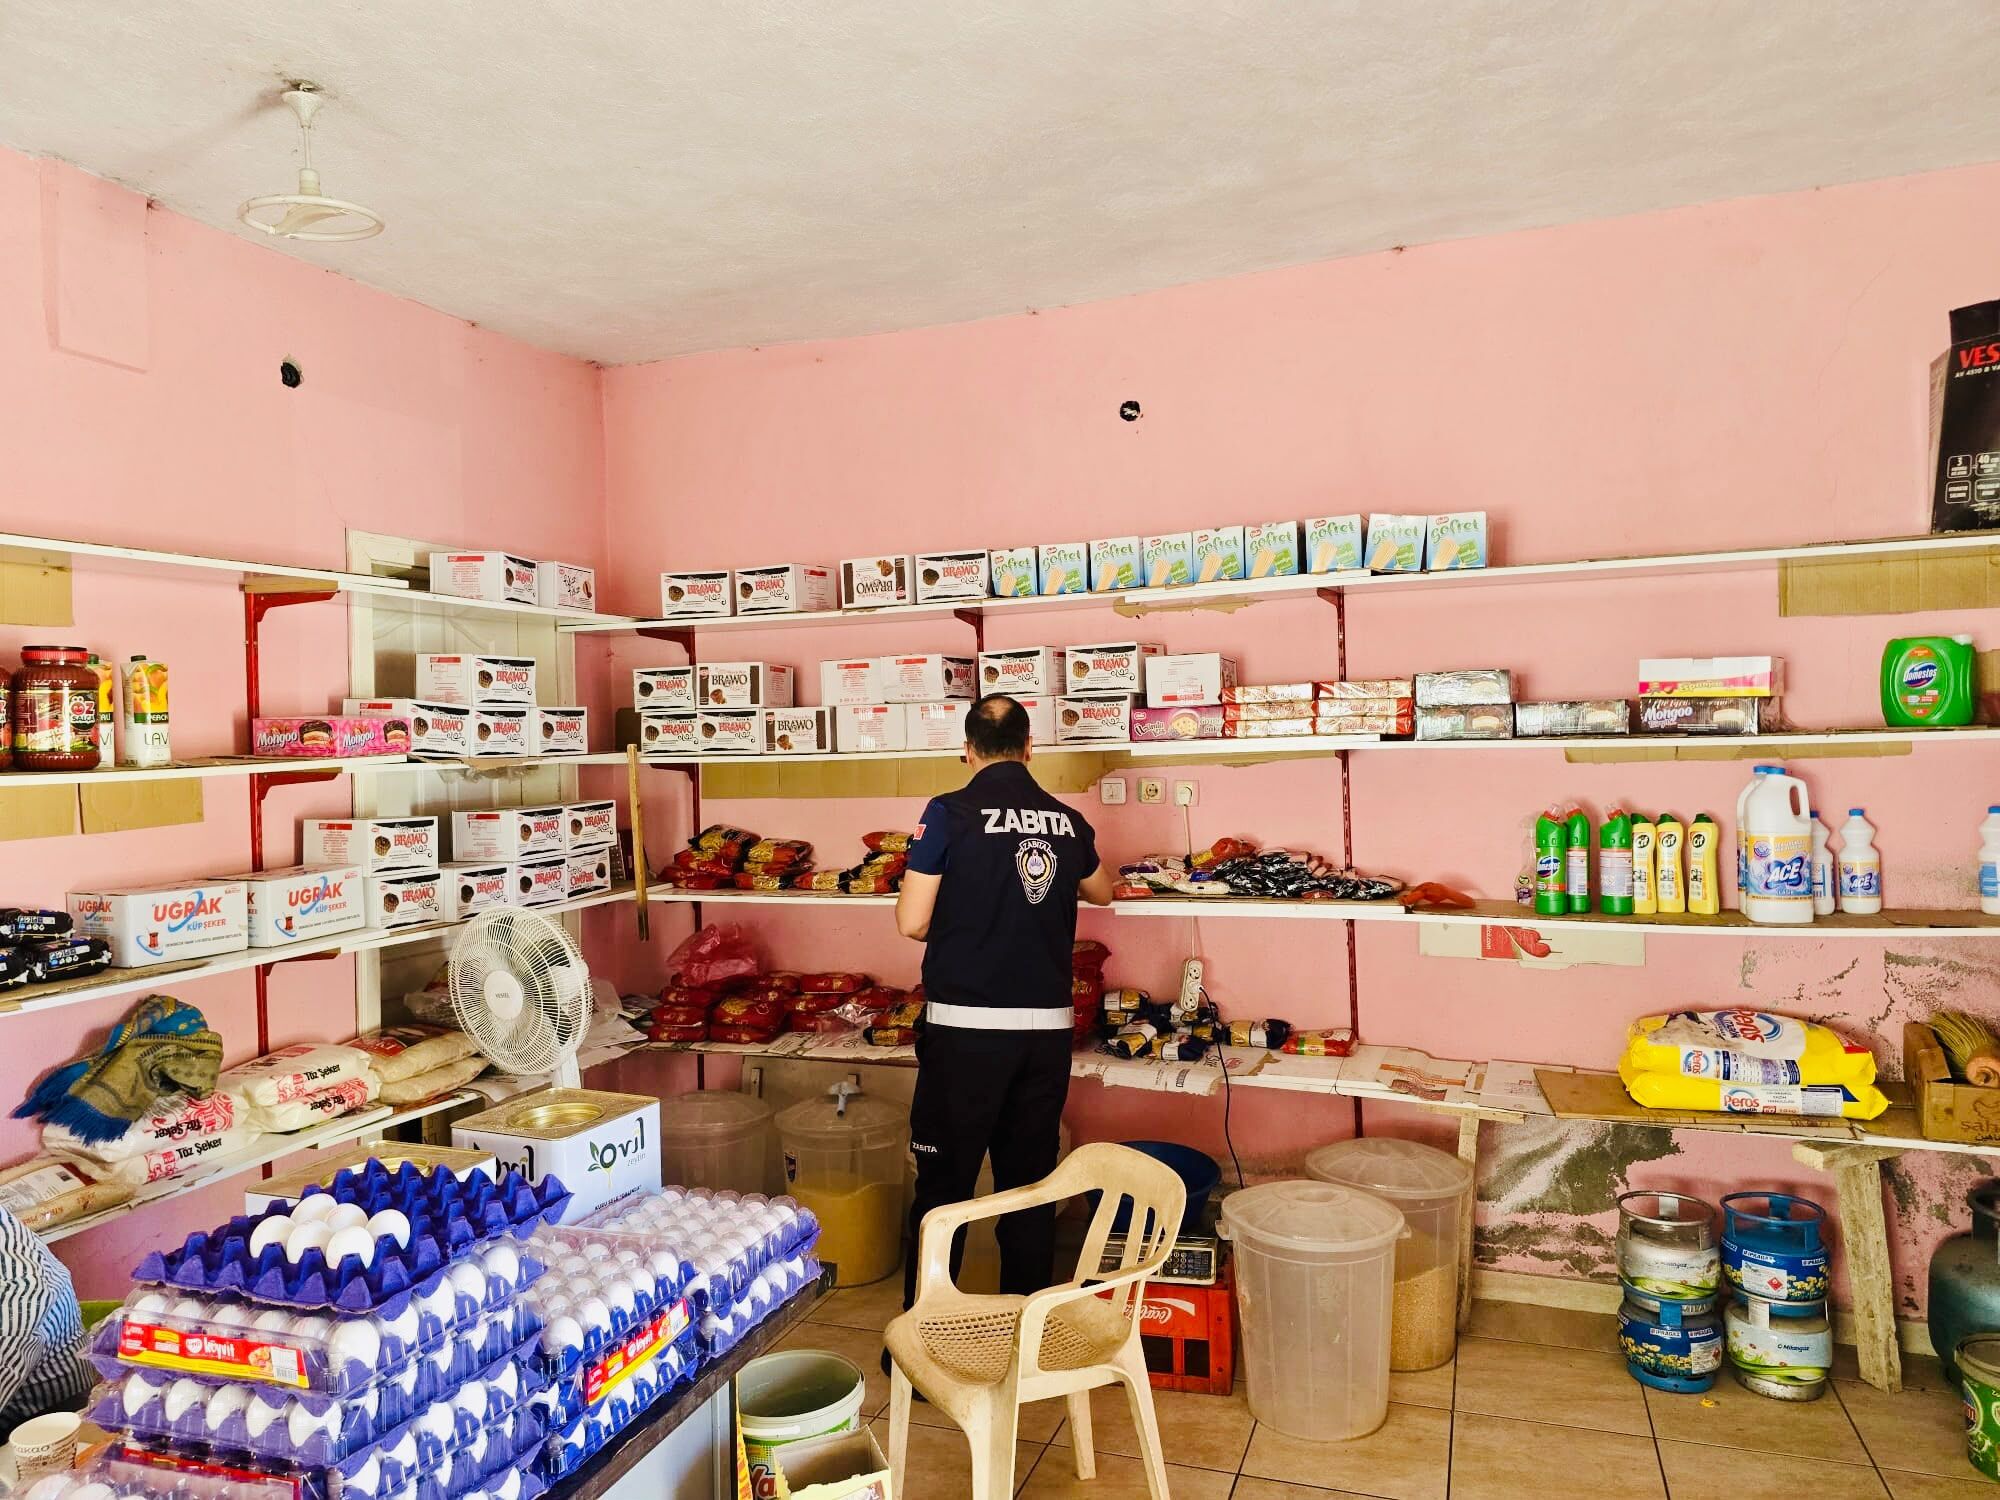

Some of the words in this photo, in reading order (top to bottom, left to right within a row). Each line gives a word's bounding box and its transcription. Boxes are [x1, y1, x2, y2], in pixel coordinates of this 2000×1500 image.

[942, 566, 980, 579] BRAWO
[687, 583, 722, 596] BRAWO
[755, 579, 785, 592] BRAWO
[1001, 663, 1035, 676] BRAWO
[1092, 657, 1130, 671] BRAWO
[496, 670, 528, 685] BRAWO
[711, 674, 748, 687] BRAWO
[655, 679, 687, 692] BRAWO
[1082, 705, 1121, 720] BRAWO
[1643, 706, 1693, 722] Mongoo
[431, 718, 463, 733] BRAWO
[493, 721, 521, 735] BRAWO
[555, 720, 581, 734] BRAWO
[661, 723, 694, 736] BRAWO
[719, 721, 751, 735] BRAWO
[777, 719, 814, 732] BRAWO
[257, 731, 299, 748] Mongoo
[343, 730, 375, 748] Mongoo
[584, 812, 610, 827] BRAWO
[980, 808, 1075, 838] ZABITA
[533, 820, 560, 835] BRAWO
[393, 832, 429, 848] BRAWO
[1022, 841, 1049, 850] ZABITA
[534, 870, 562, 885] BRAWO
[1767, 862, 1801, 883] ACE
[476, 879, 504, 895] BRAWO
[1852, 876, 1871, 889] ACE
[402, 886, 436, 903] BRAWO
[203, 918, 226, 930] ŞEKER
[1723, 1094, 1760, 1109] Peros
[195, 1138, 222, 1155] Şeker
